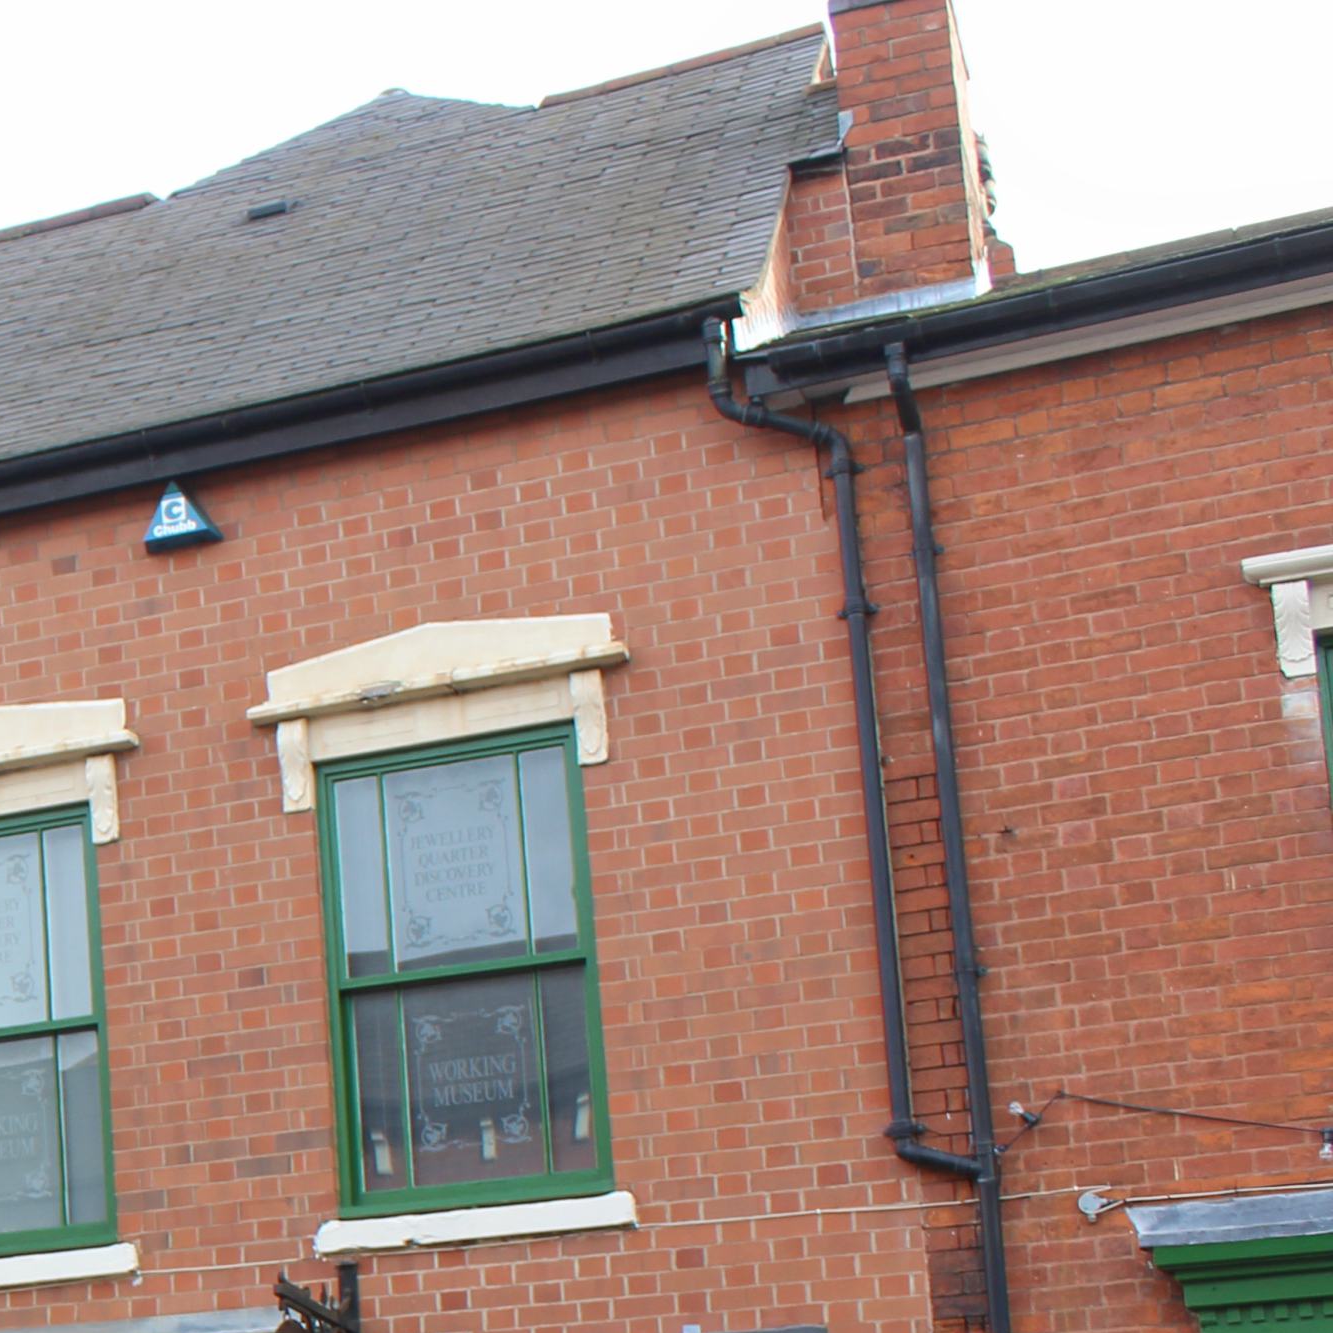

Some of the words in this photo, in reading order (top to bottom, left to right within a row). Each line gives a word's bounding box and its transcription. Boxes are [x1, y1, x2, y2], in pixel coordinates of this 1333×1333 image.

[412, 824, 494, 849] JEWELLERY
[419, 844, 488, 869] QUARTER
[414, 862, 493, 887] DISCOVERY
[426, 881, 486, 903] CENTRE
[430, 1053, 516, 1082] WORKING
[434, 1078, 514, 1108] MUSEUM
